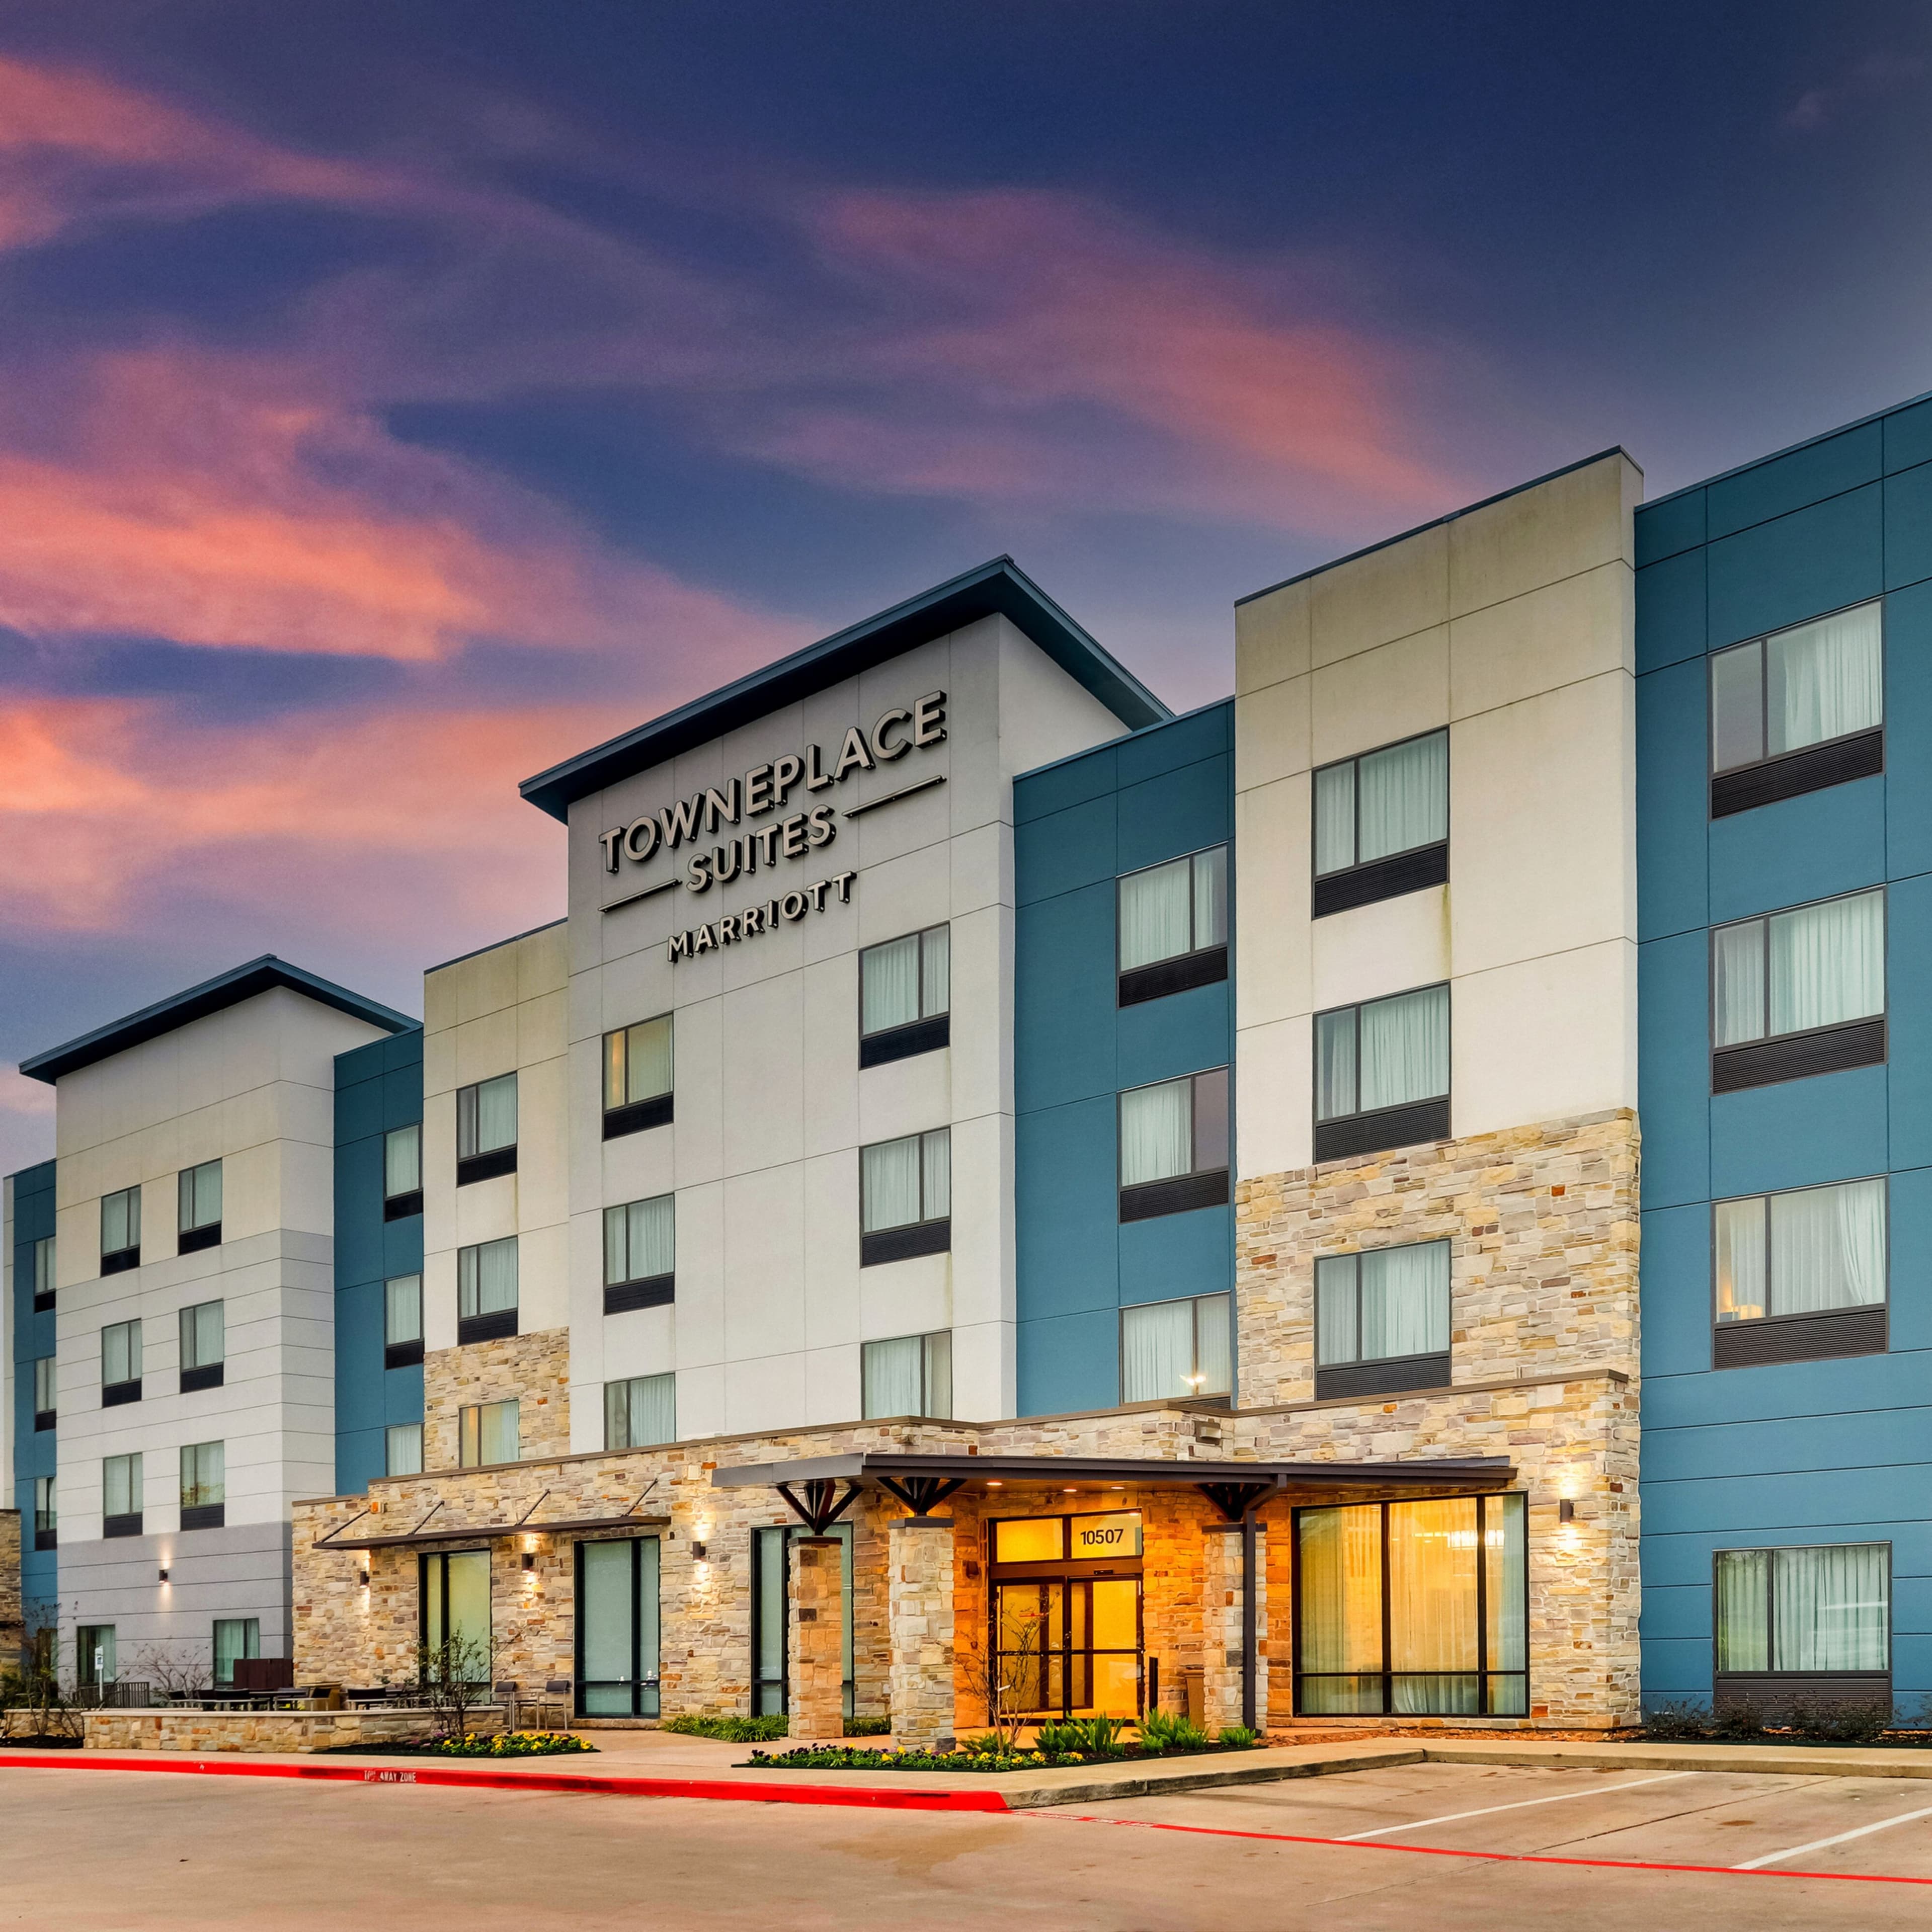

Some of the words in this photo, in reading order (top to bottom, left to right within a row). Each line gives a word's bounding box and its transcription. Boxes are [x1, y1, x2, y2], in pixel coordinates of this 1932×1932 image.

[599, 690, 947, 873] TOWNEPLACE
[686, 804, 836, 894] SUITES
[668, 871, 857, 963] MARRIOTT
[1080, 1529, 1123, 1545] 10507
[378, 1772, 397, 1782] AWAY
[400, 1772, 417, 1782] ZONE
